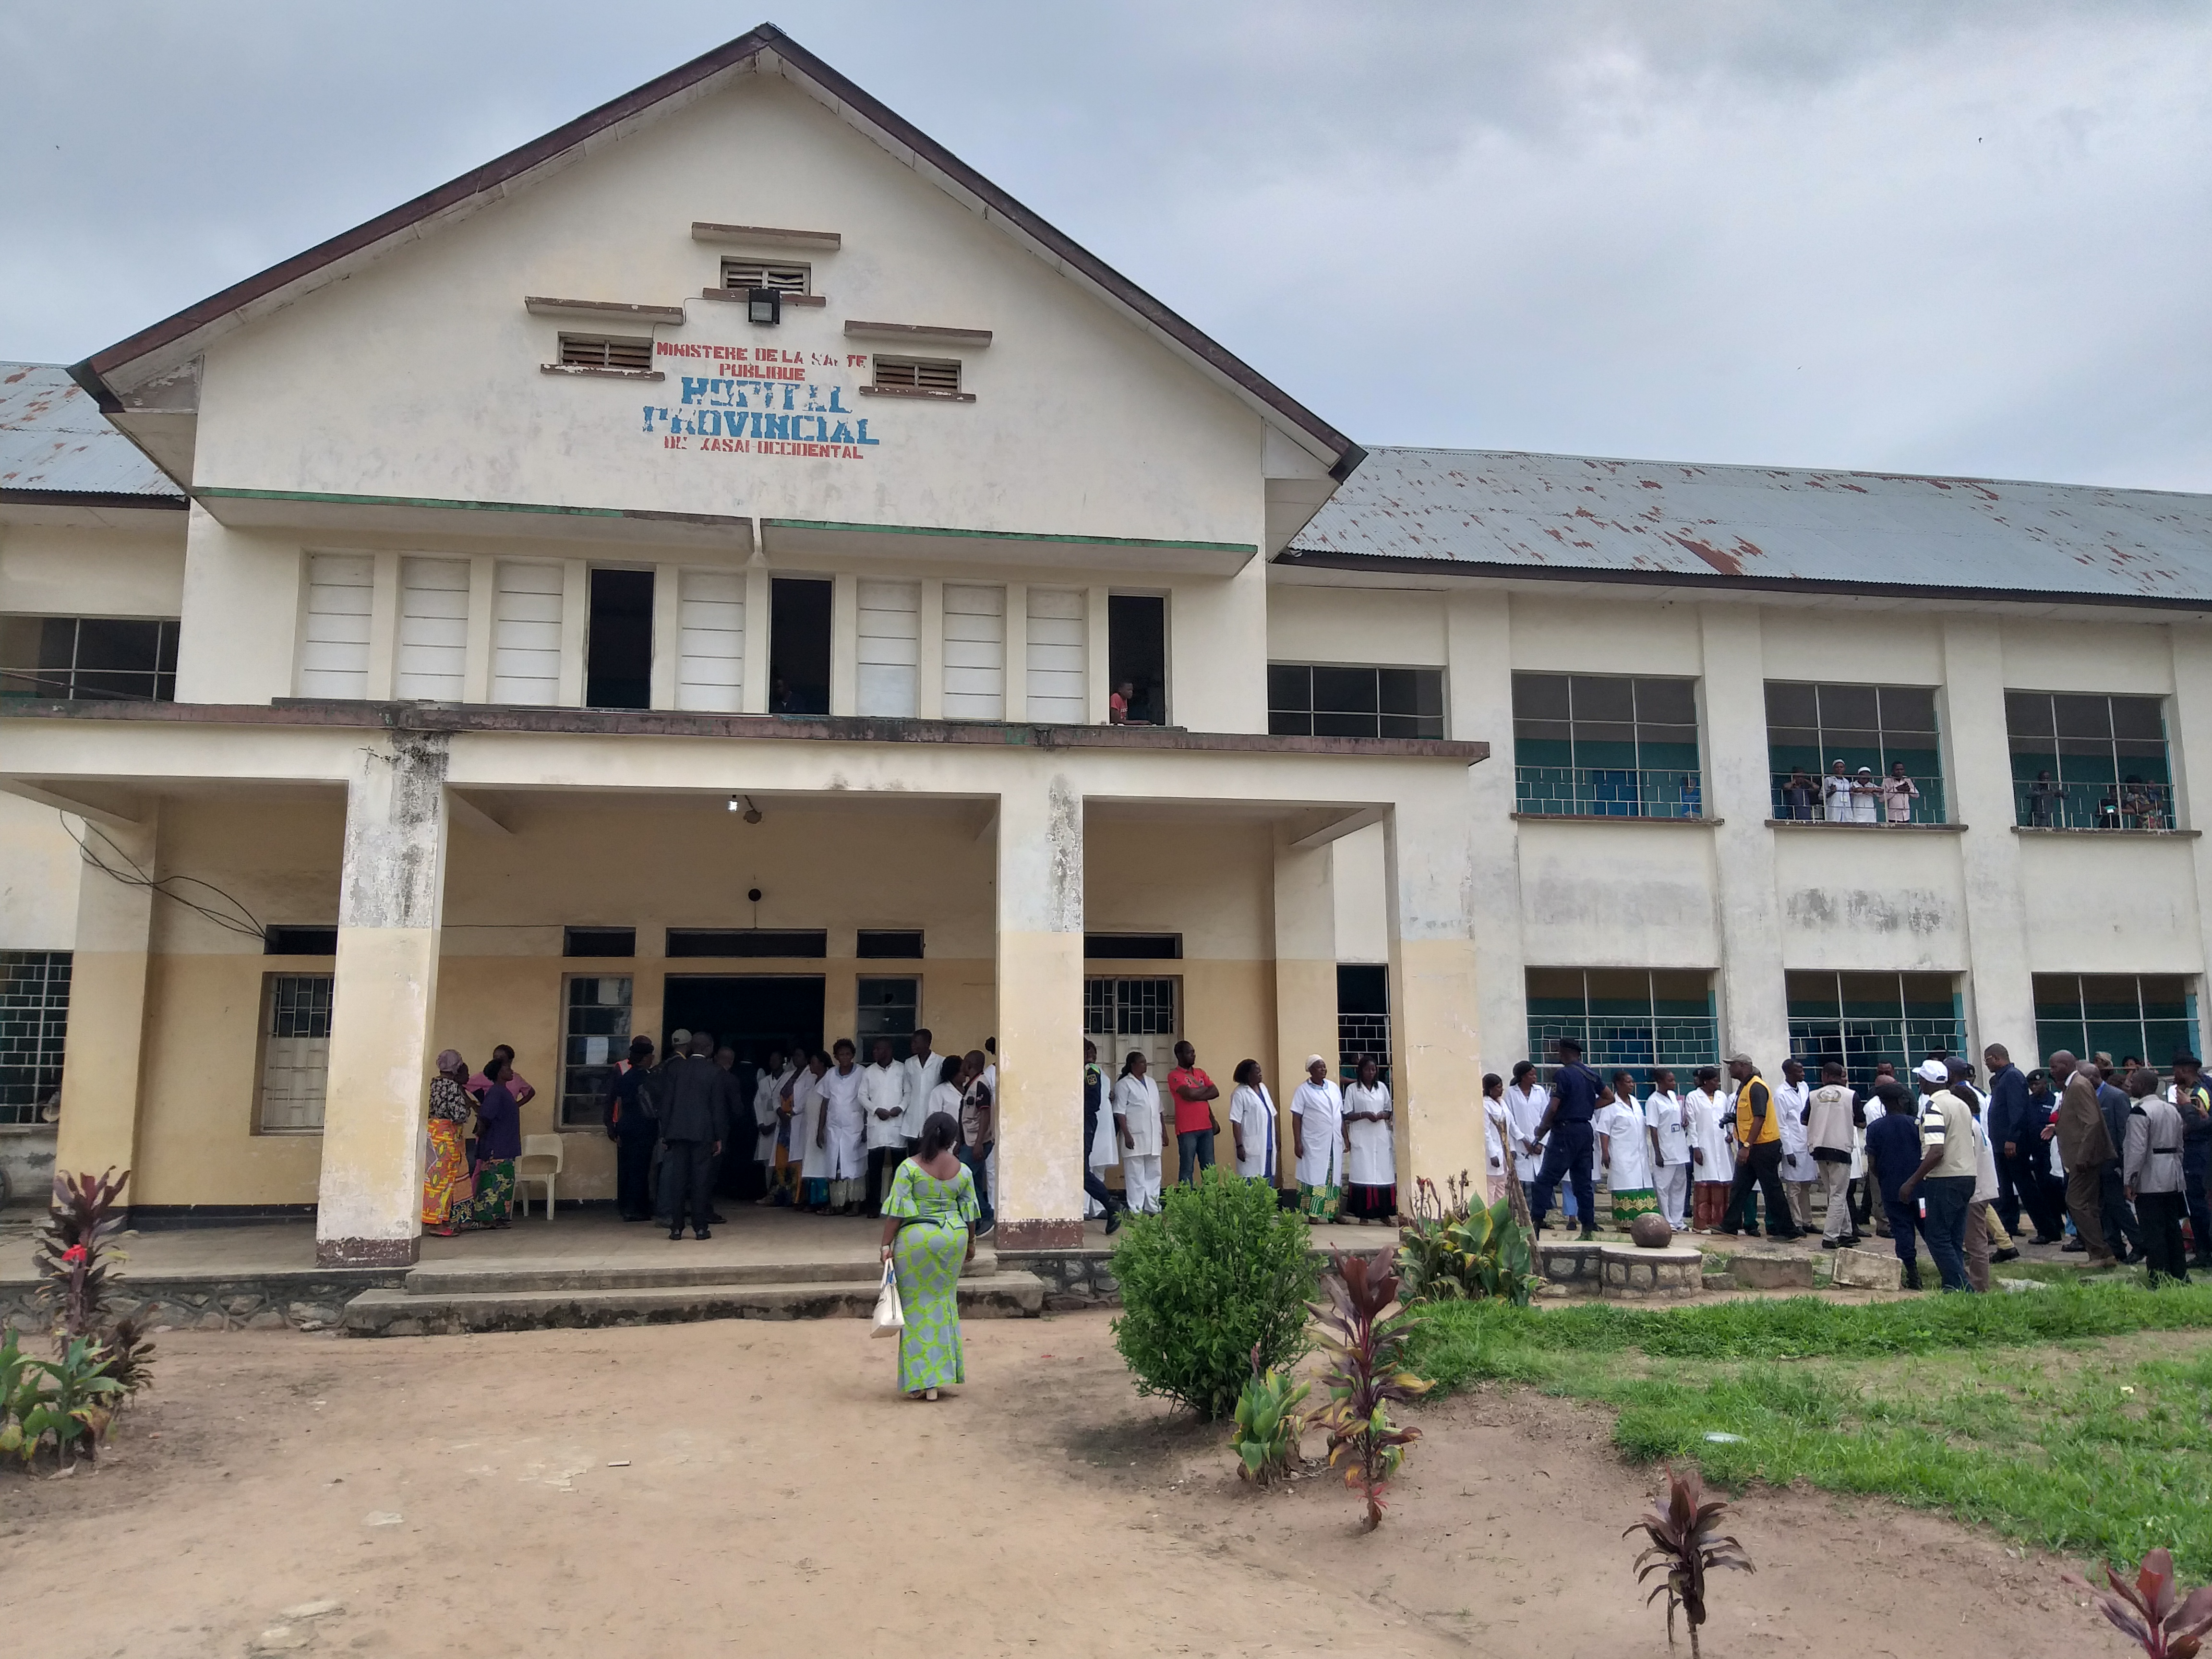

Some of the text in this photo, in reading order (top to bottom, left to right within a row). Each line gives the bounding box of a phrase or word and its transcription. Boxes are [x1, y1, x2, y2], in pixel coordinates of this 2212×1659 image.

[657, 342, 748, 361] MINISTERE
[755, 348, 778, 362] DE
[782, 349, 804, 364] LA
[720, 363, 805, 381] PUBLIQUE
